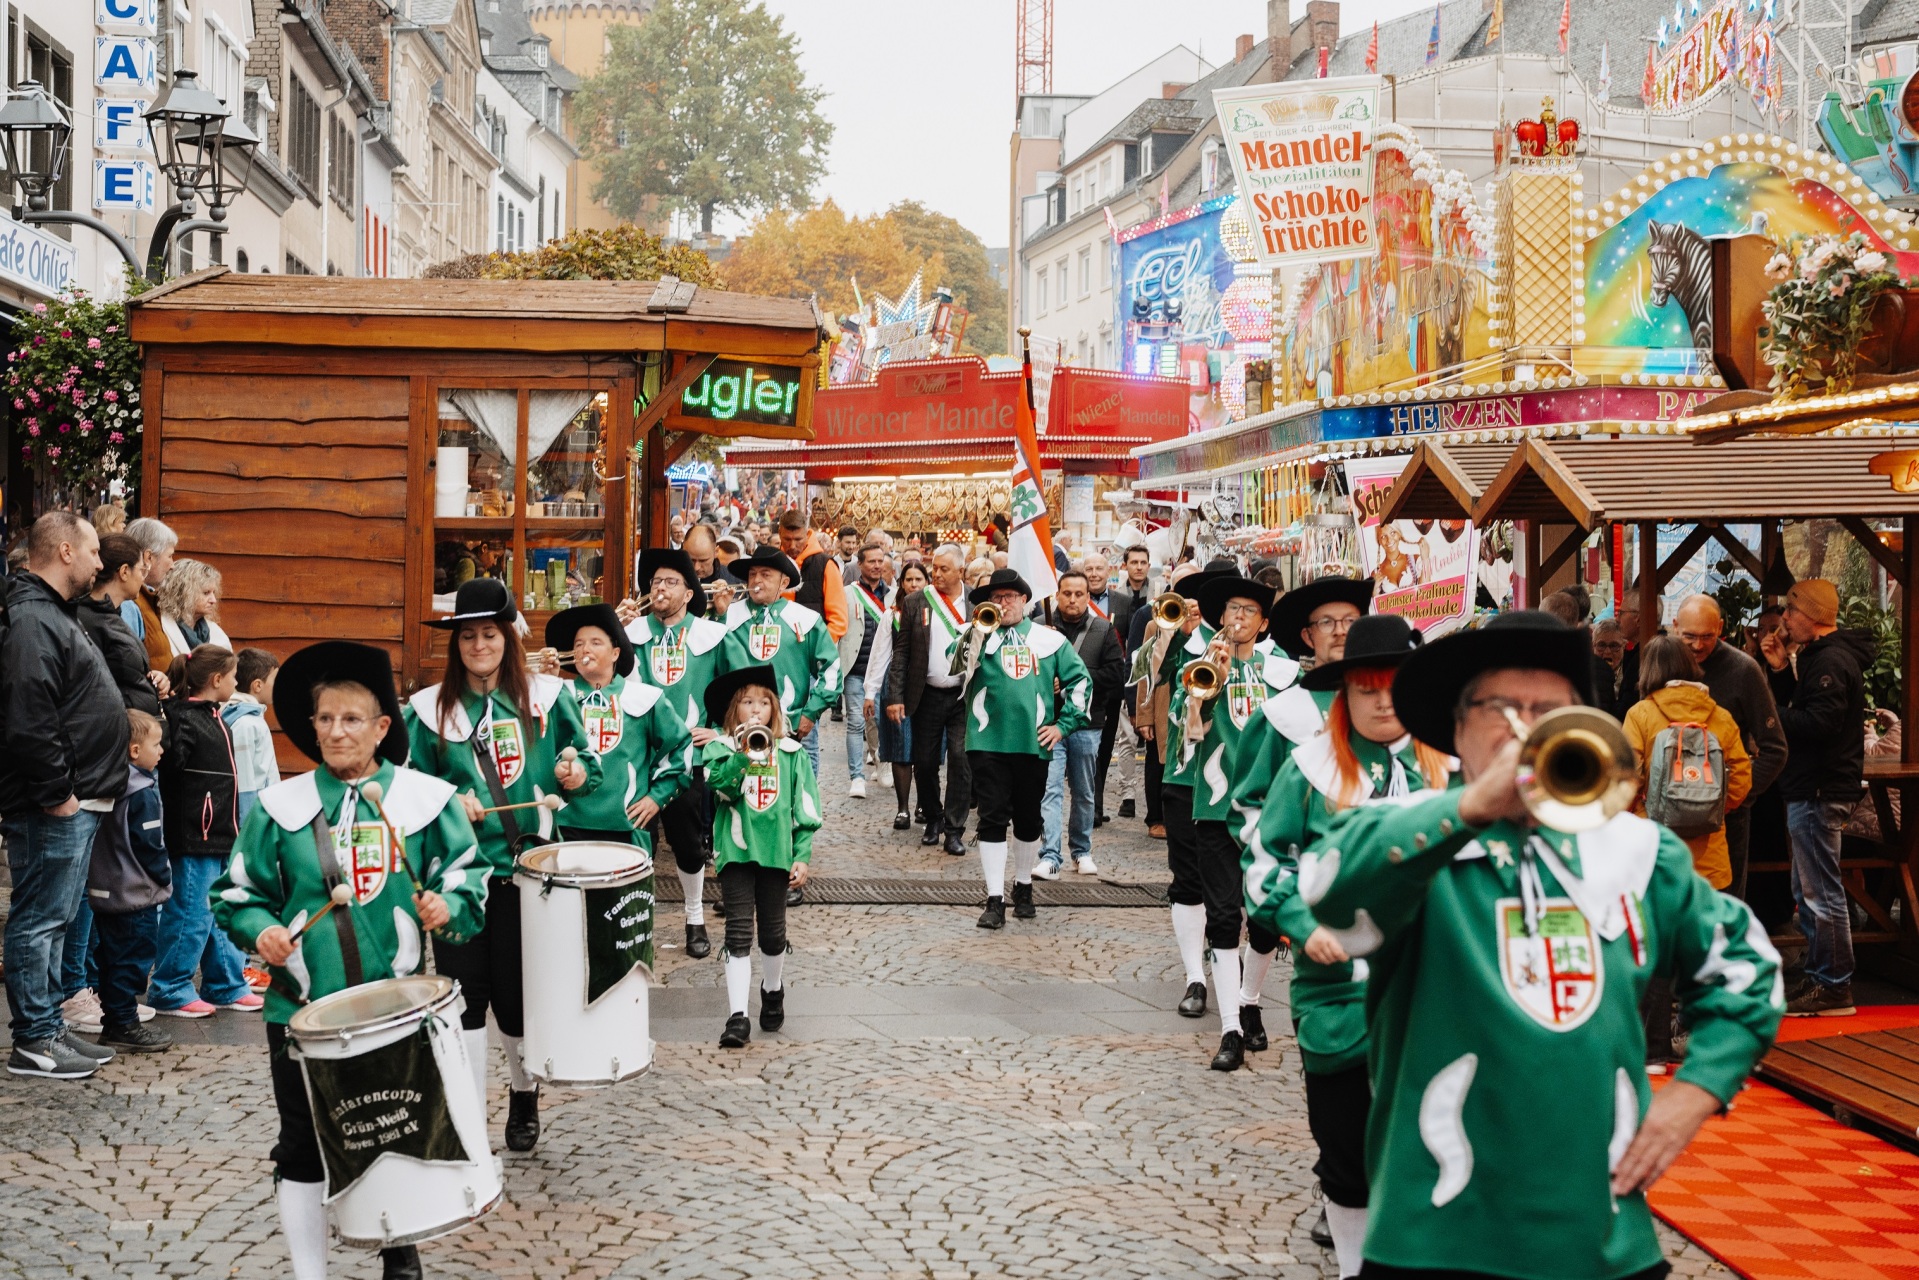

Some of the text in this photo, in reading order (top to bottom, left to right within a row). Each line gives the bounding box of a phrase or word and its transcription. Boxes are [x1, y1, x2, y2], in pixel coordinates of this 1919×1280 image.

[1253, 122, 1353, 139] SEIT ÜBER 40 JAHREN!
[1240, 131, 1372, 172] Mandel-
[1249, 165, 1363, 189] Spezialitäten
[1296, 183, 1321, 191] UND
[1253, 185, 1370, 223] Schoko-
[1262, 215, 1368, 254] früchte
[0, 229, 25, 276] afe
[826, 398, 1019, 437] Wiener Mande
[1076, 390, 1125, 427] Wiener
[1119, 407, 1180, 426] Mandeln
[1390, 397, 1525, 436] HERZEN
[939, 445, 983, 457] Gebrannte
[1045, 442, 1131, 454] Alpenbrot Popcor
[1386, 593, 1414, 612] feinster
[1416, 582, 1465, 603] Pralinen-
[342, 1106, 410, 1136] Grün-Weiß
[344, 1137, 375, 1151] Mayen
